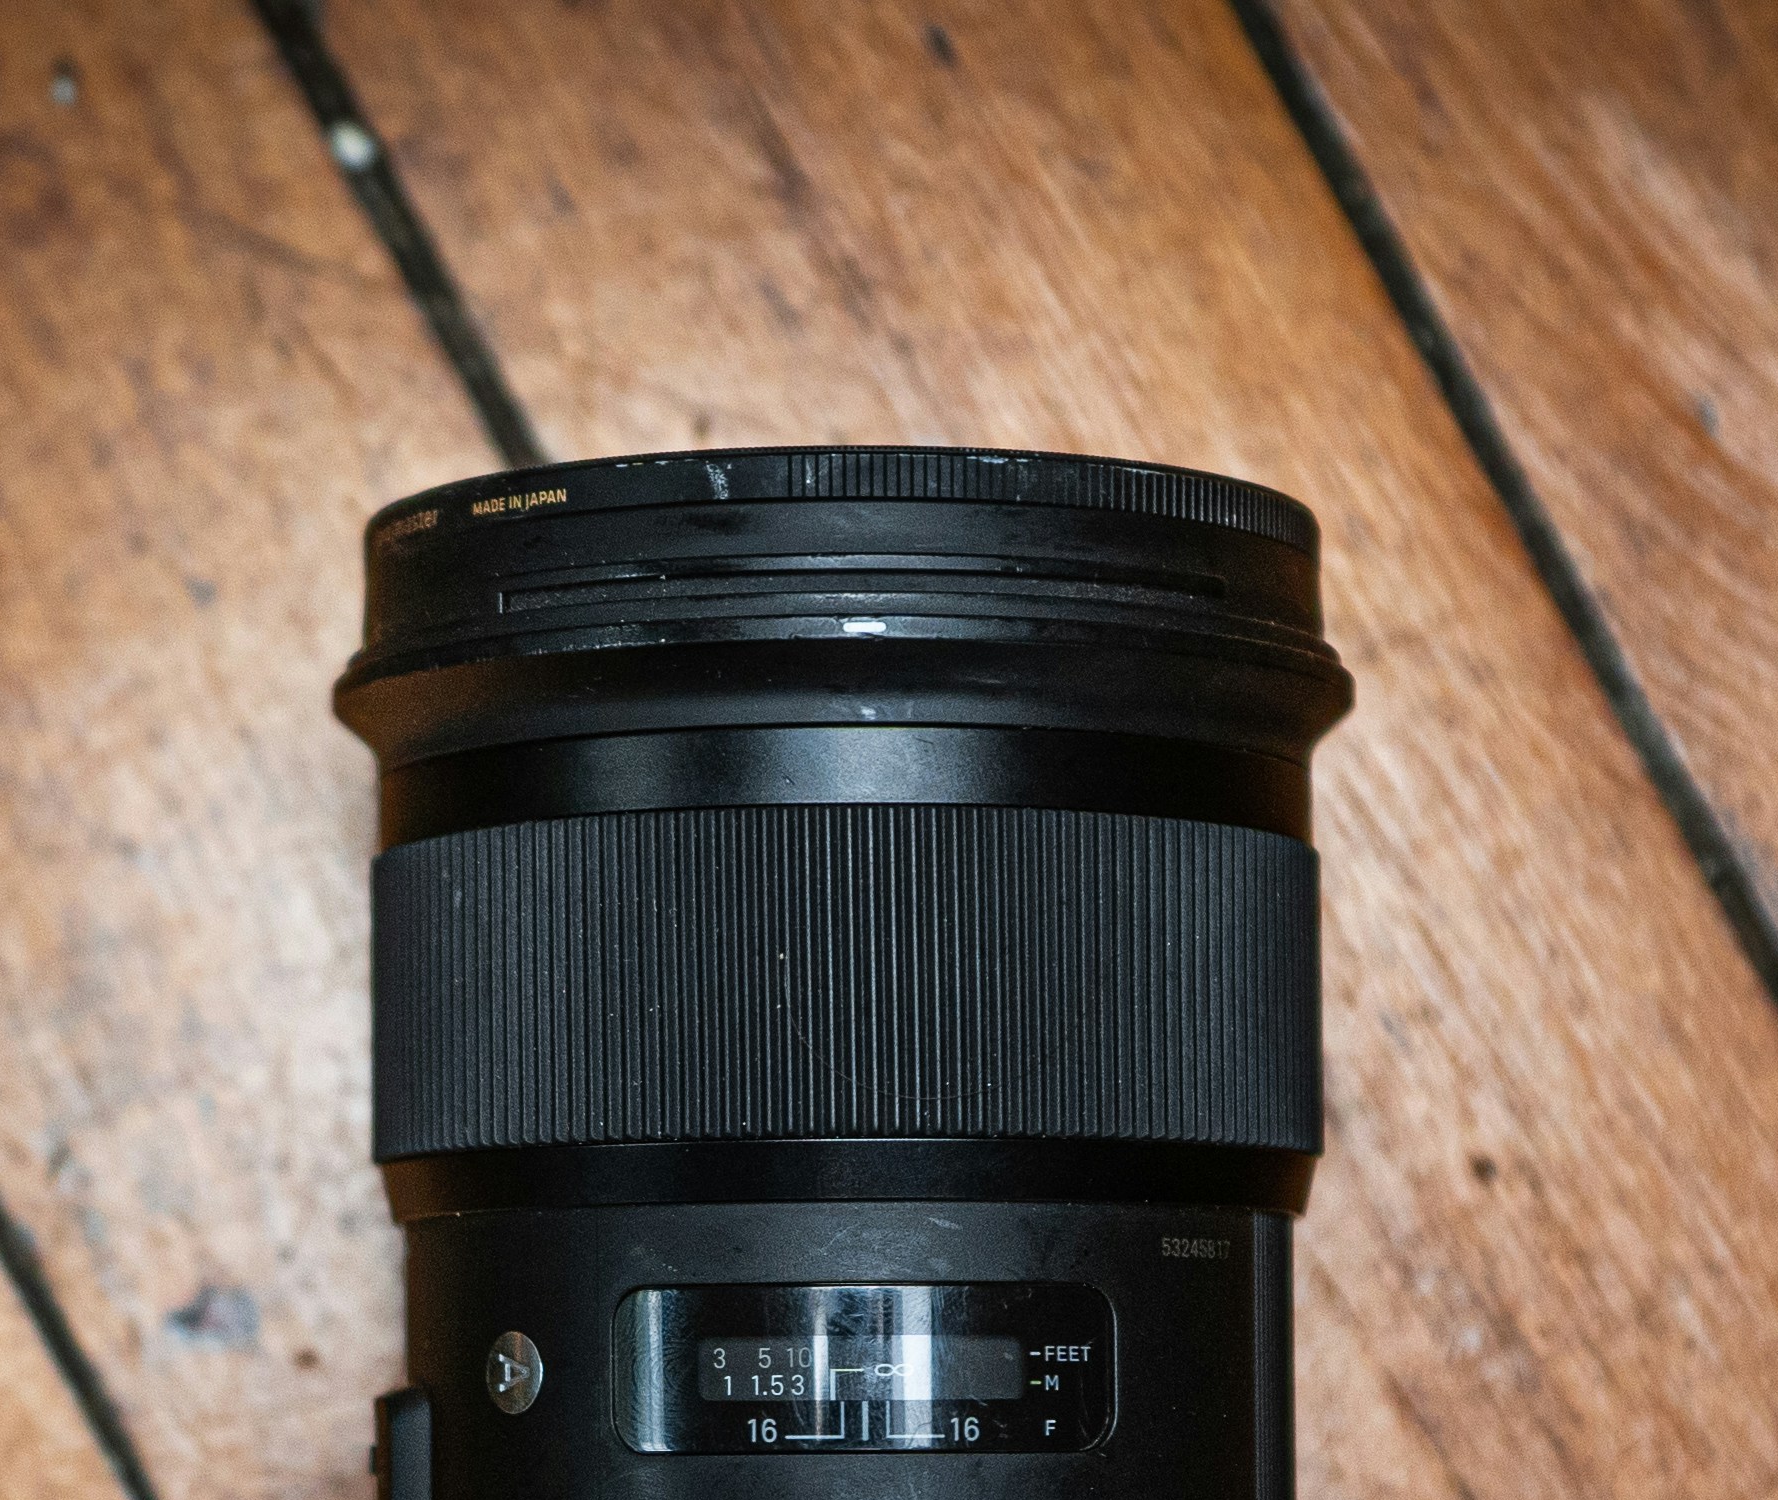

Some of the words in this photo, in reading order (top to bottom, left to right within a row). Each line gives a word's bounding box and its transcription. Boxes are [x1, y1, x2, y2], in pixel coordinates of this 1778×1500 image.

[472, 498, 506, 515] MADE
[508, 493, 523, 511] IN
[525, 489, 567, 510] JAPAN
[712, 1347, 727, 1370] 3
[757, 1347, 772, 1369] 5
[786, 1346, 813, 1369] 10
[1044, 1345, 1092, 1362] FEET
[723, 1374, 733, 1397] 1
[751, 1373, 785, 1397] 1.5
[790, 1373, 806, 1397] 3
[1044, 1374, 1060, 1392] M
[746, 1417, 778, 1443] 16
[949, 1416, 981, 1442] 16
[1044, 1419, 1057, 1437] F
